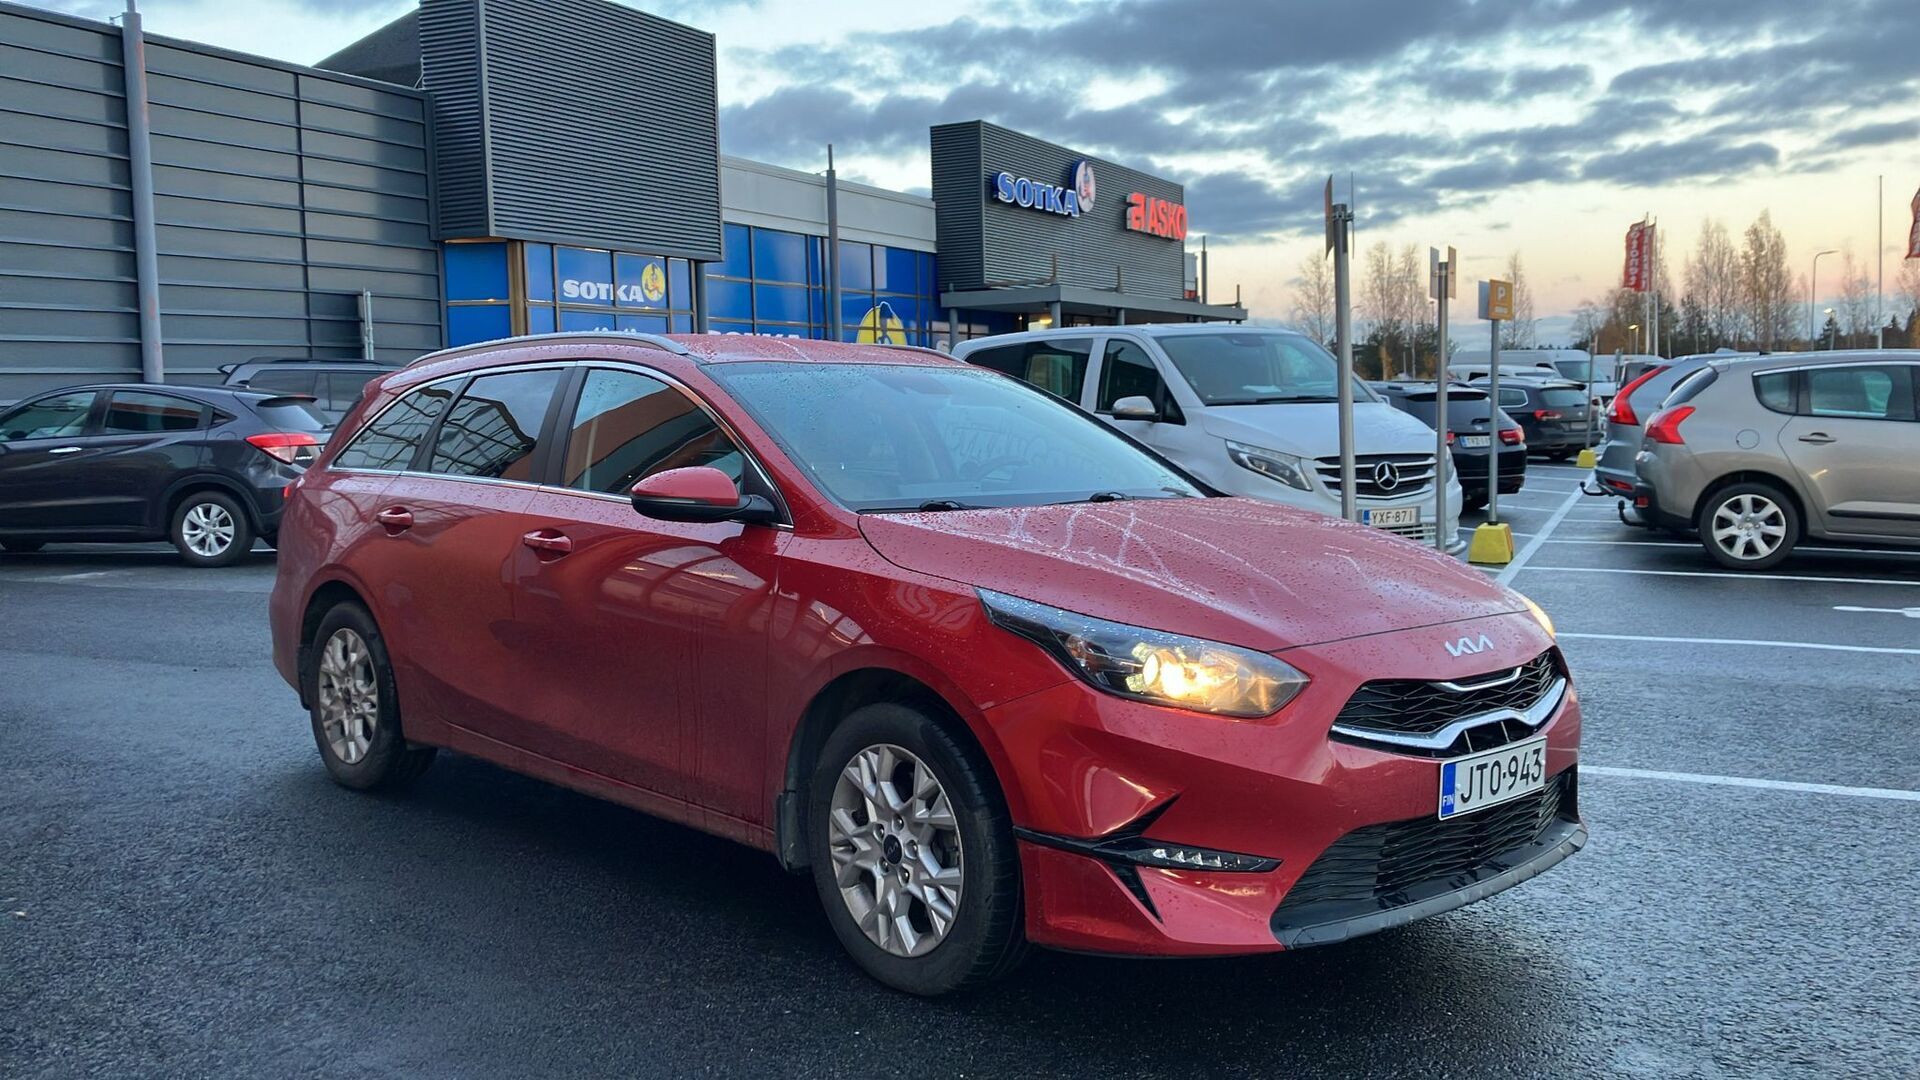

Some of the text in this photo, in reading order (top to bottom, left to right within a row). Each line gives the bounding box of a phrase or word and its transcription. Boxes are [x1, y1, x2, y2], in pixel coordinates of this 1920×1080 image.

[994, 171, 1079, 217] SOTKA
[1147, 197, 1188, 241] ASKO
[563, 280, 645, 302] SOTKA
[1372, 510, 1413, 524] YXF-871
[1445, 634, 1494, 657] KIA
[1460, 747, 1542, 804] JTO-943
